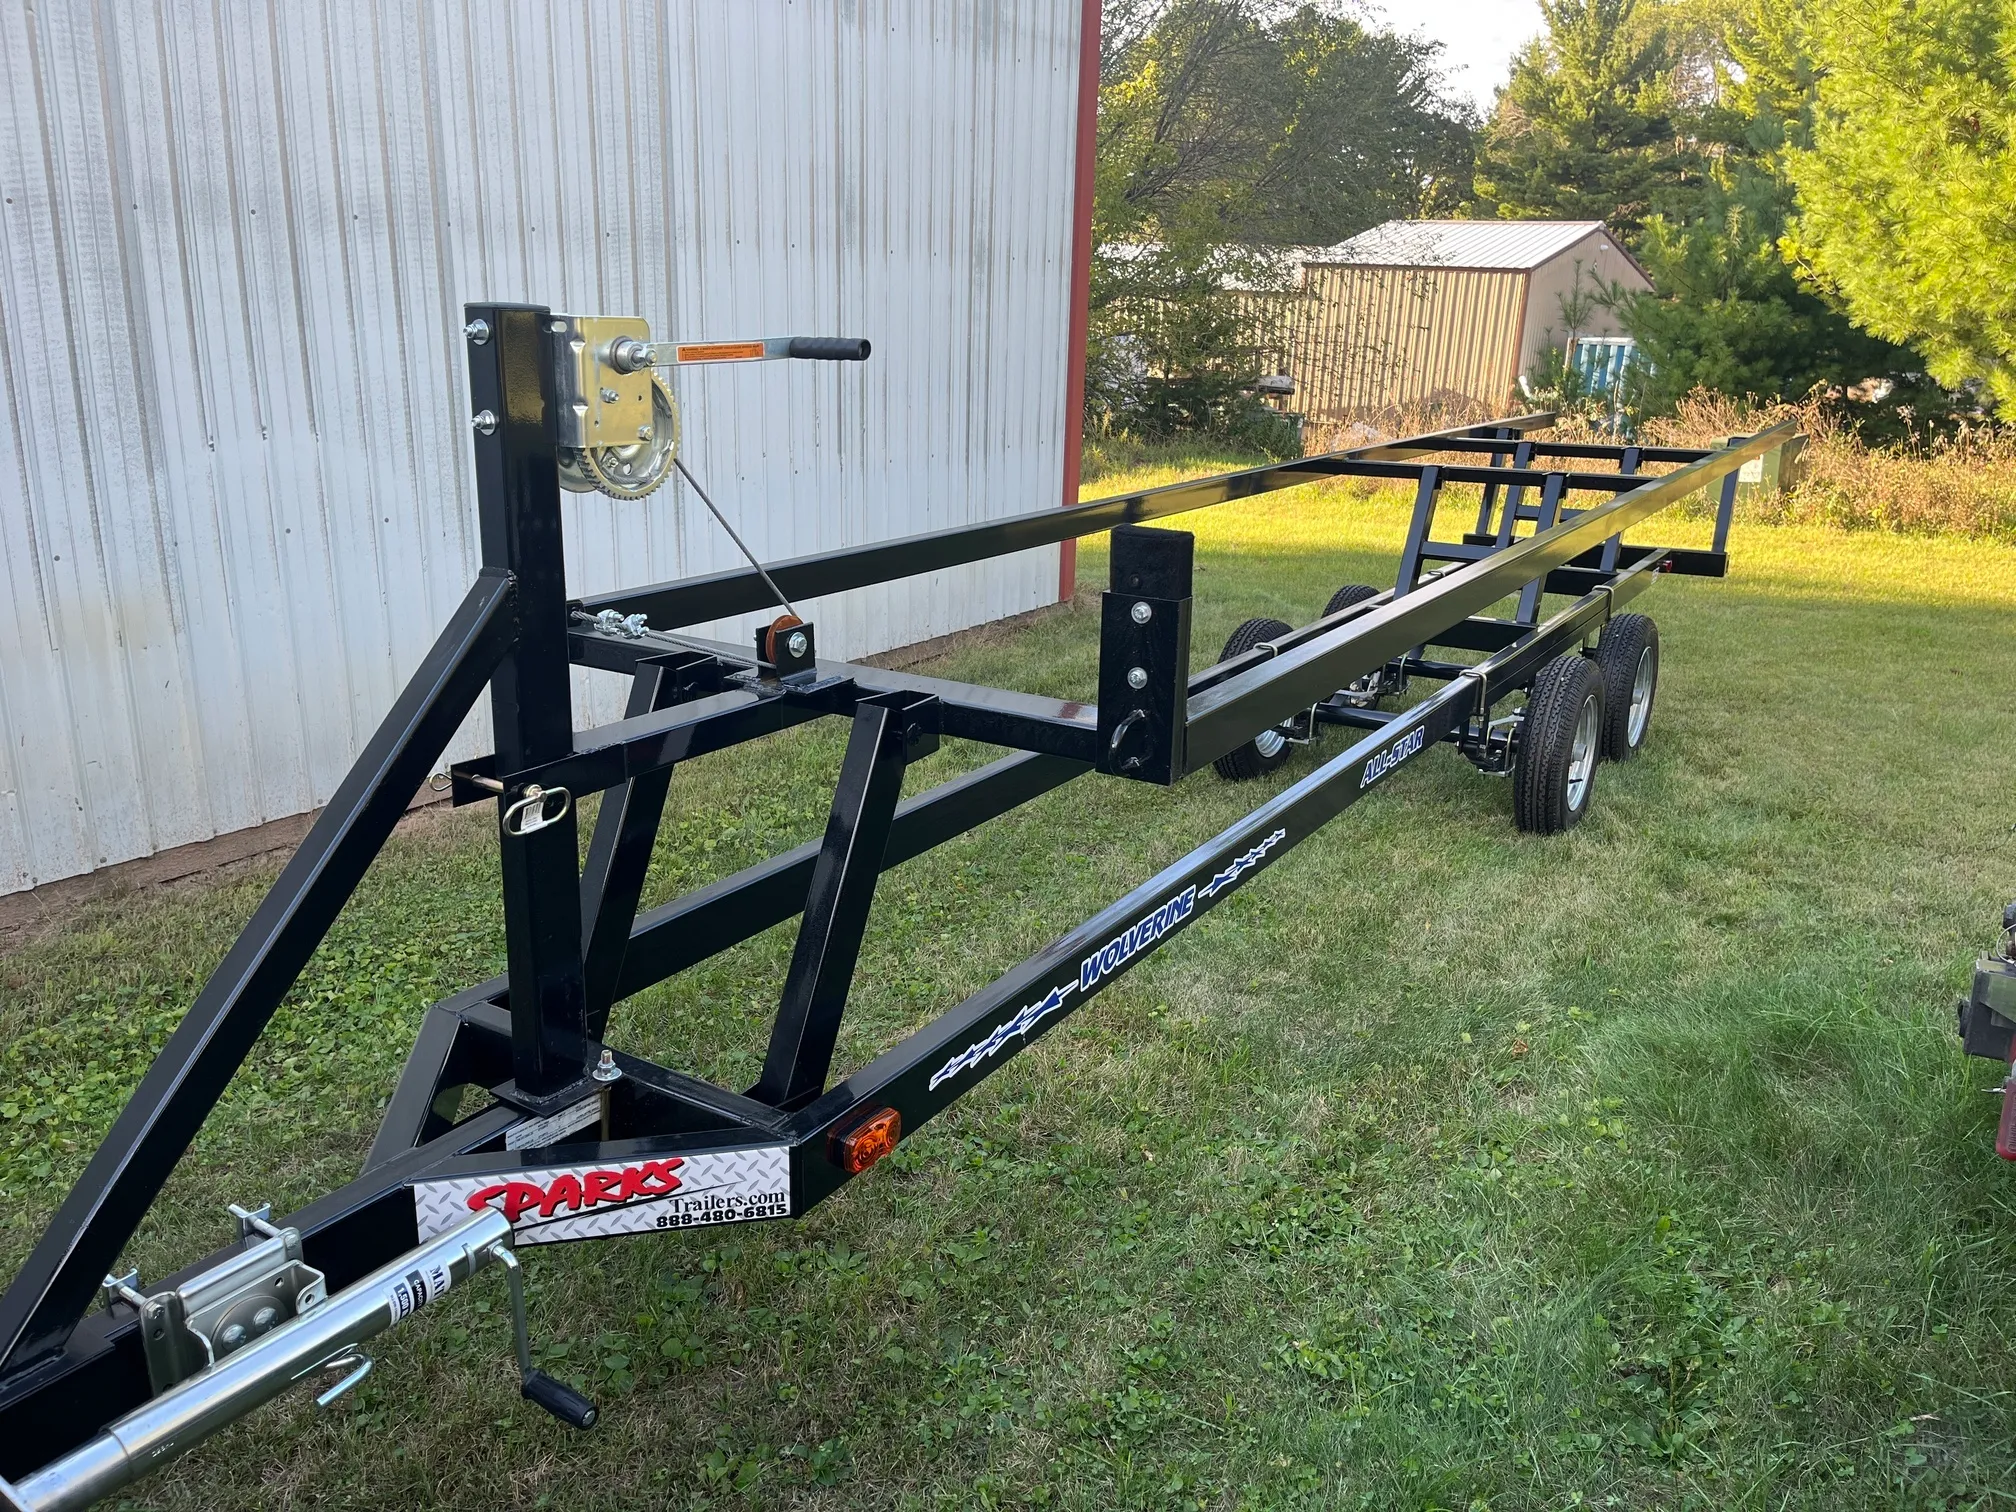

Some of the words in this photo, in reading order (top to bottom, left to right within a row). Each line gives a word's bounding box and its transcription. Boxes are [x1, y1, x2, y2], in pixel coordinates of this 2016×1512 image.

[1360, 725, 1425, 788] ALL-STAR
[1081, 884, 1196, 992] WOLVERINE
[467, 1157, 684, 1222] SPARKS
[656, 1203, 787, 1228] 888-480-6815
[669, 1191, 785, 1213] Trailers.com
